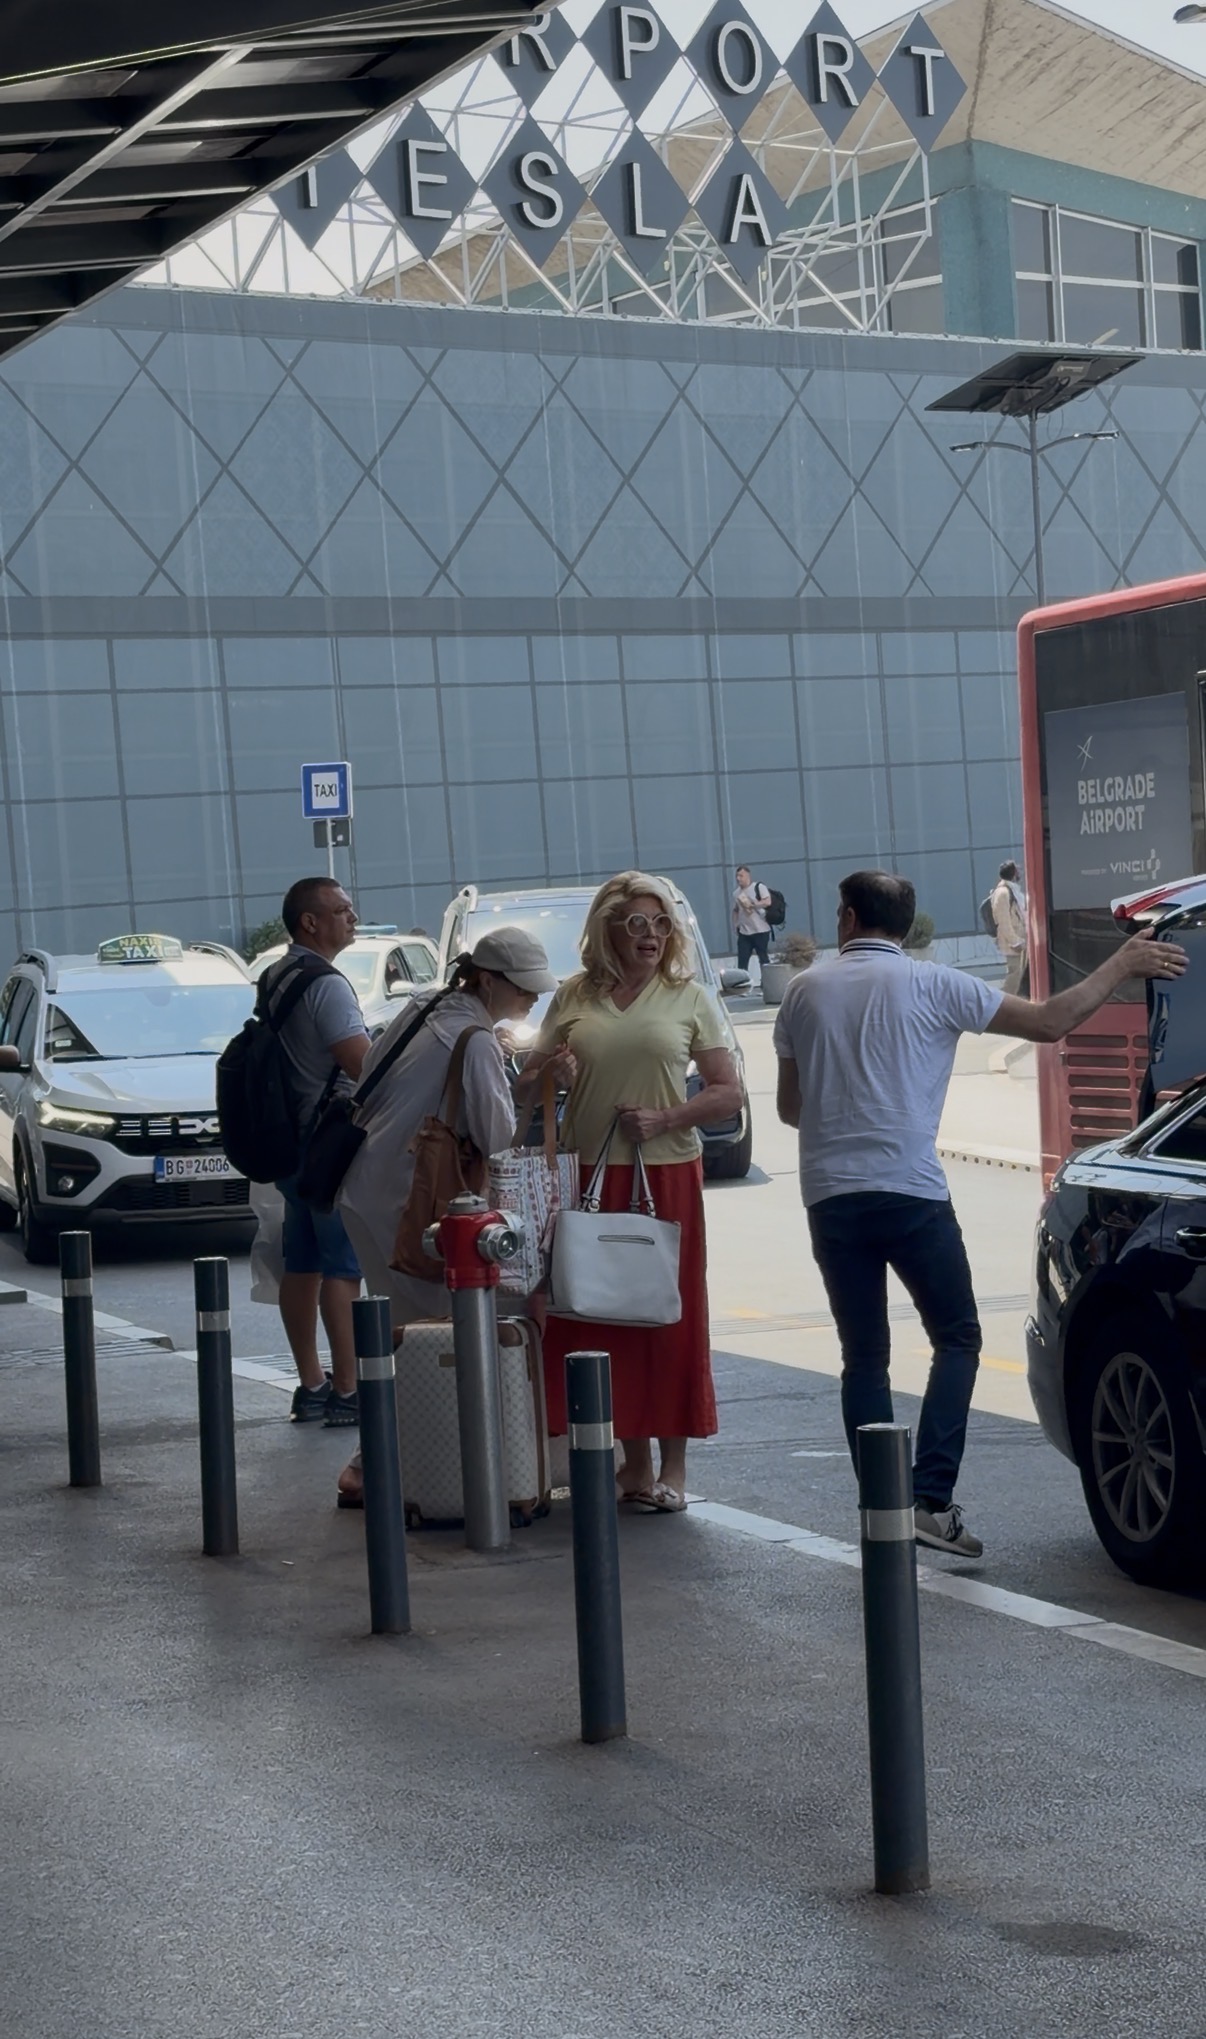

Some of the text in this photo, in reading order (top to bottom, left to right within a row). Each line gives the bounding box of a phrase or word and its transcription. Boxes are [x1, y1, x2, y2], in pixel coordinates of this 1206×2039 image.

[314, 783, 337, 797] TAXI
[1077, 772, 1155, 804] BELGRADE
[1109, 860, 1144, 874] VINCI
[121, 945, 164, 958] TAXI
[166, 1160, 184, 1175] BG
